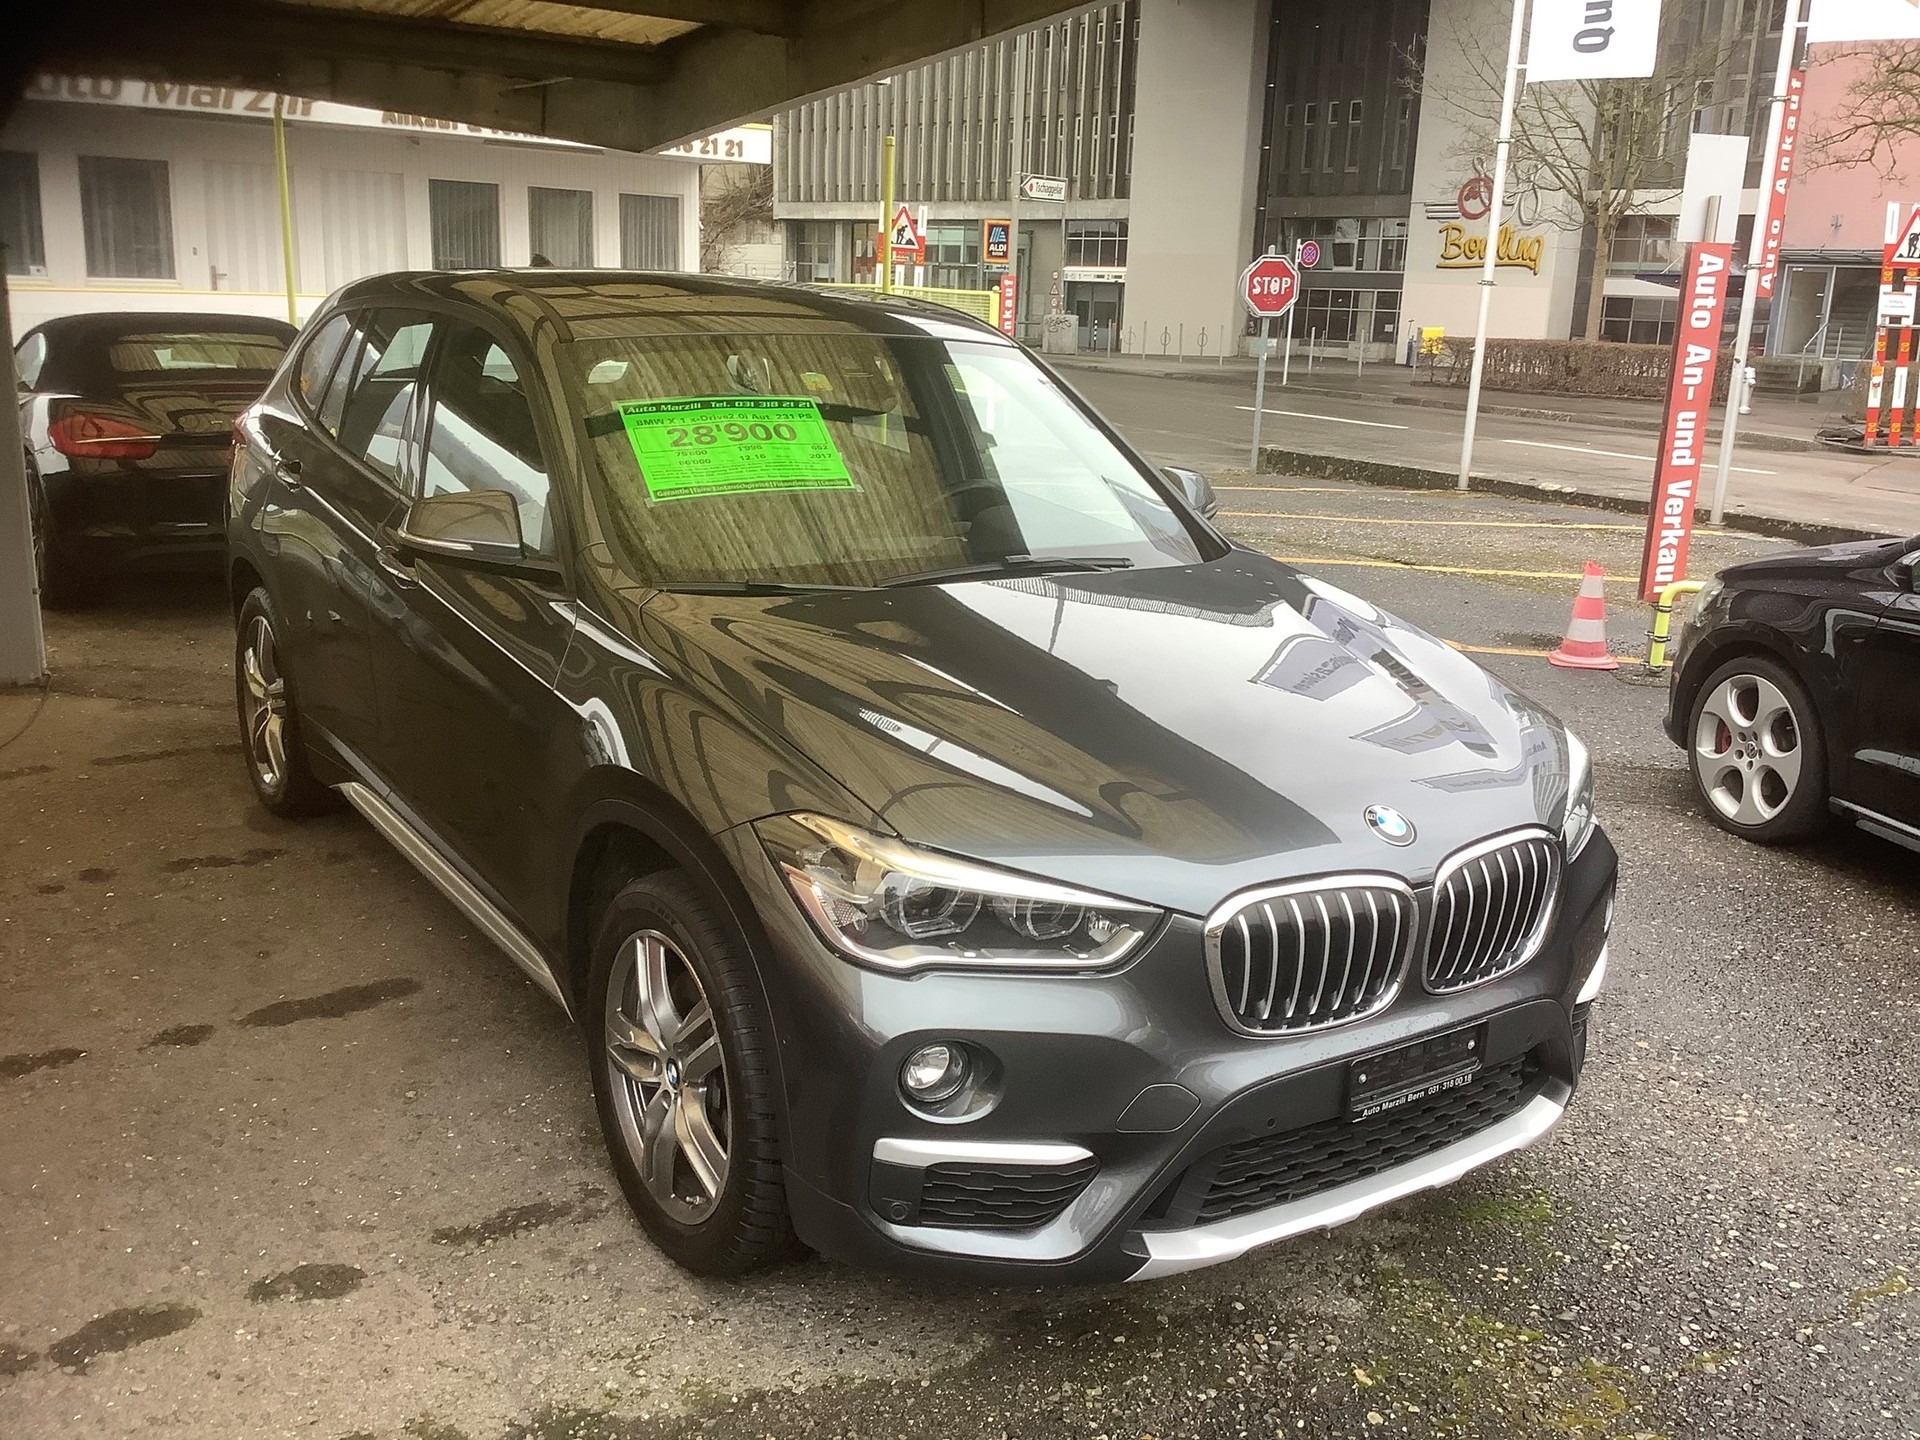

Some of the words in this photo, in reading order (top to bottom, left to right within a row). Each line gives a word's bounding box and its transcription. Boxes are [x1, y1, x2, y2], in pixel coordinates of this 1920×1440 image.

[700, 137, 718, 155] 21
[725, 139, 743, 157] 21
[1761, 218, 1782, 290] Auto
[1775, 78, 1802, 195] Ankauf
[989, 243, 1007, 252] ALDI
[1252, 276, 1291, 295] STOP
[1690, 252, 1725, 329] Auto
[1682, 343, 1712, 400] An-
[627, 406, 656, 414] Auto
[636, 418, 664, 426] BMW
[666, 422, 797, 448] 28'900
[1671, 411, 1698, 466] und
[1362, 1105, 1380, 1117] Auto
[1407, 1090, 1425, 1102] Bern
